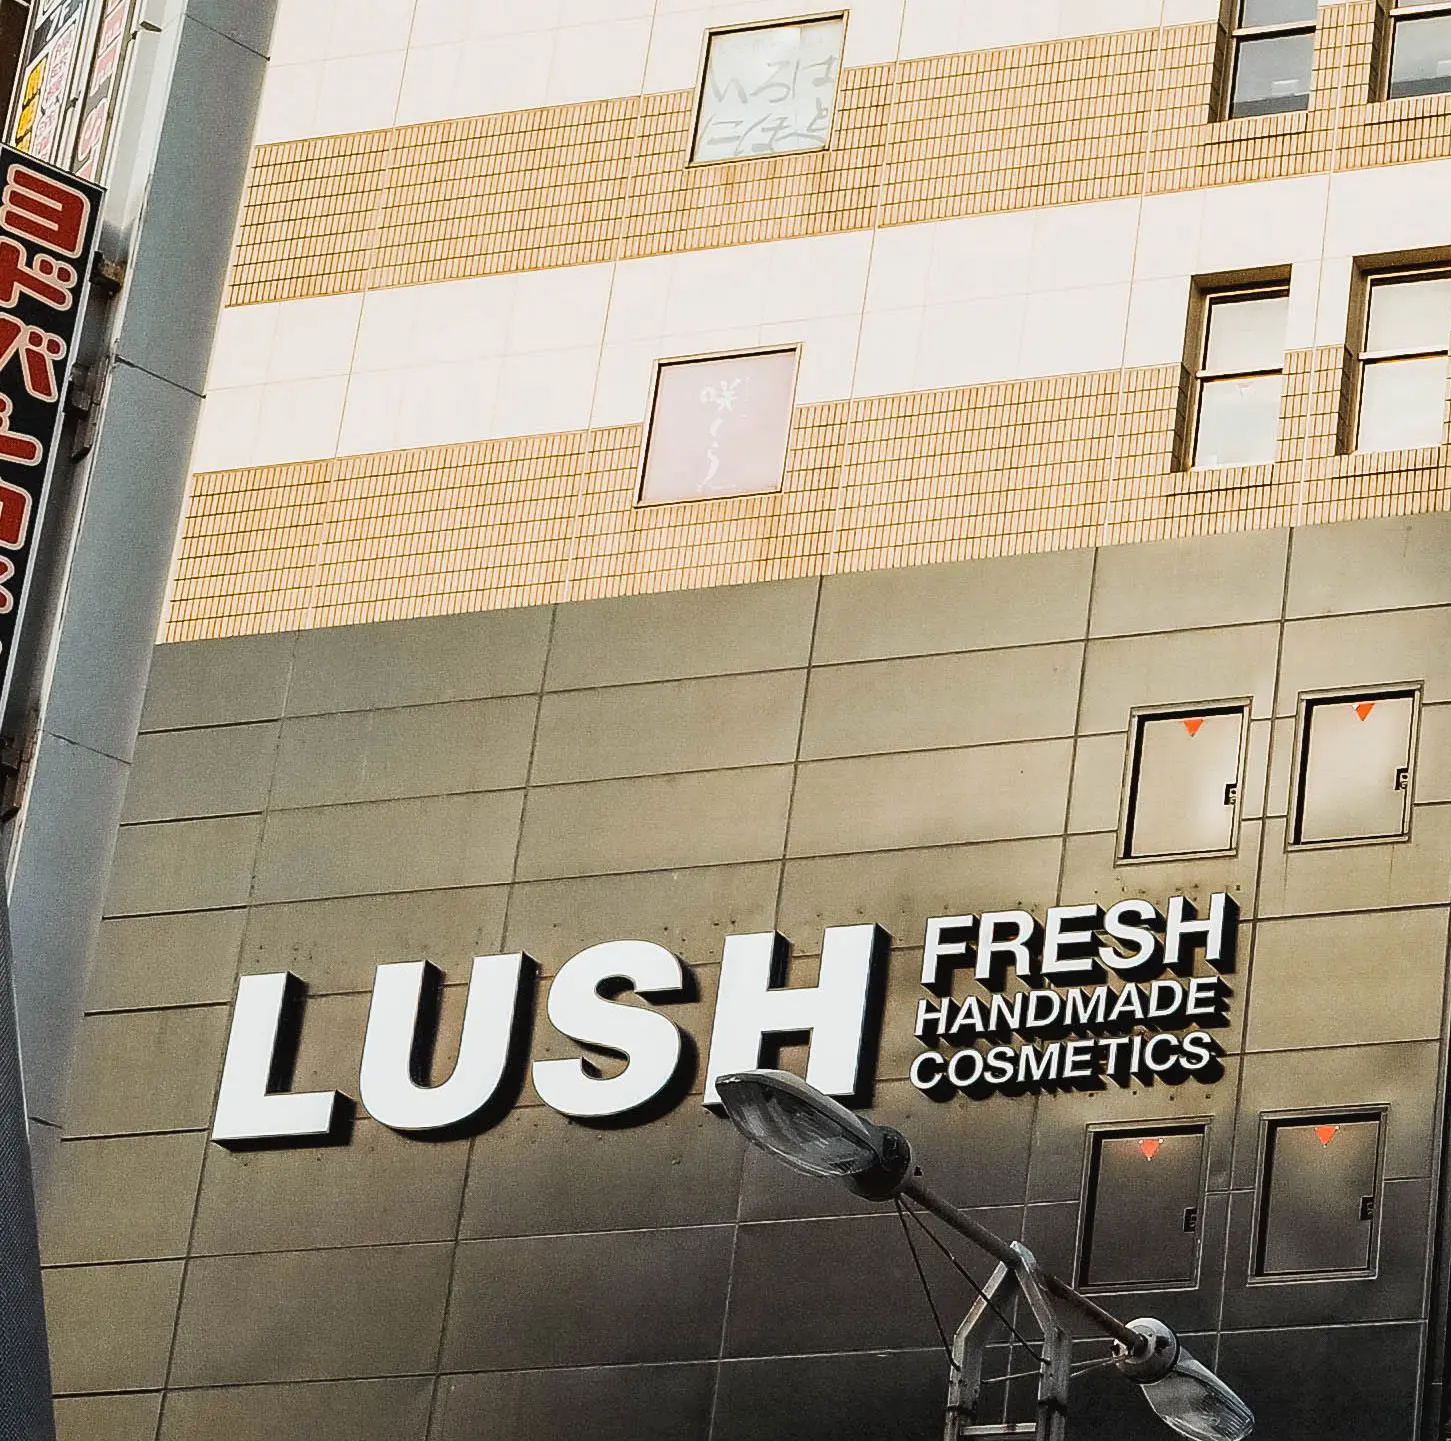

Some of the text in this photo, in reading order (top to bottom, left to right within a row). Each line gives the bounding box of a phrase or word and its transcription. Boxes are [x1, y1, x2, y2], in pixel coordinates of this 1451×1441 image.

[921, 890, 1230, 984] FRESH
[212, 922, 880, 1142] LUSH
[914, 976, 1221, 1038] HANDMADE
[908, 1029, 1215, 1092] COSMETICS
